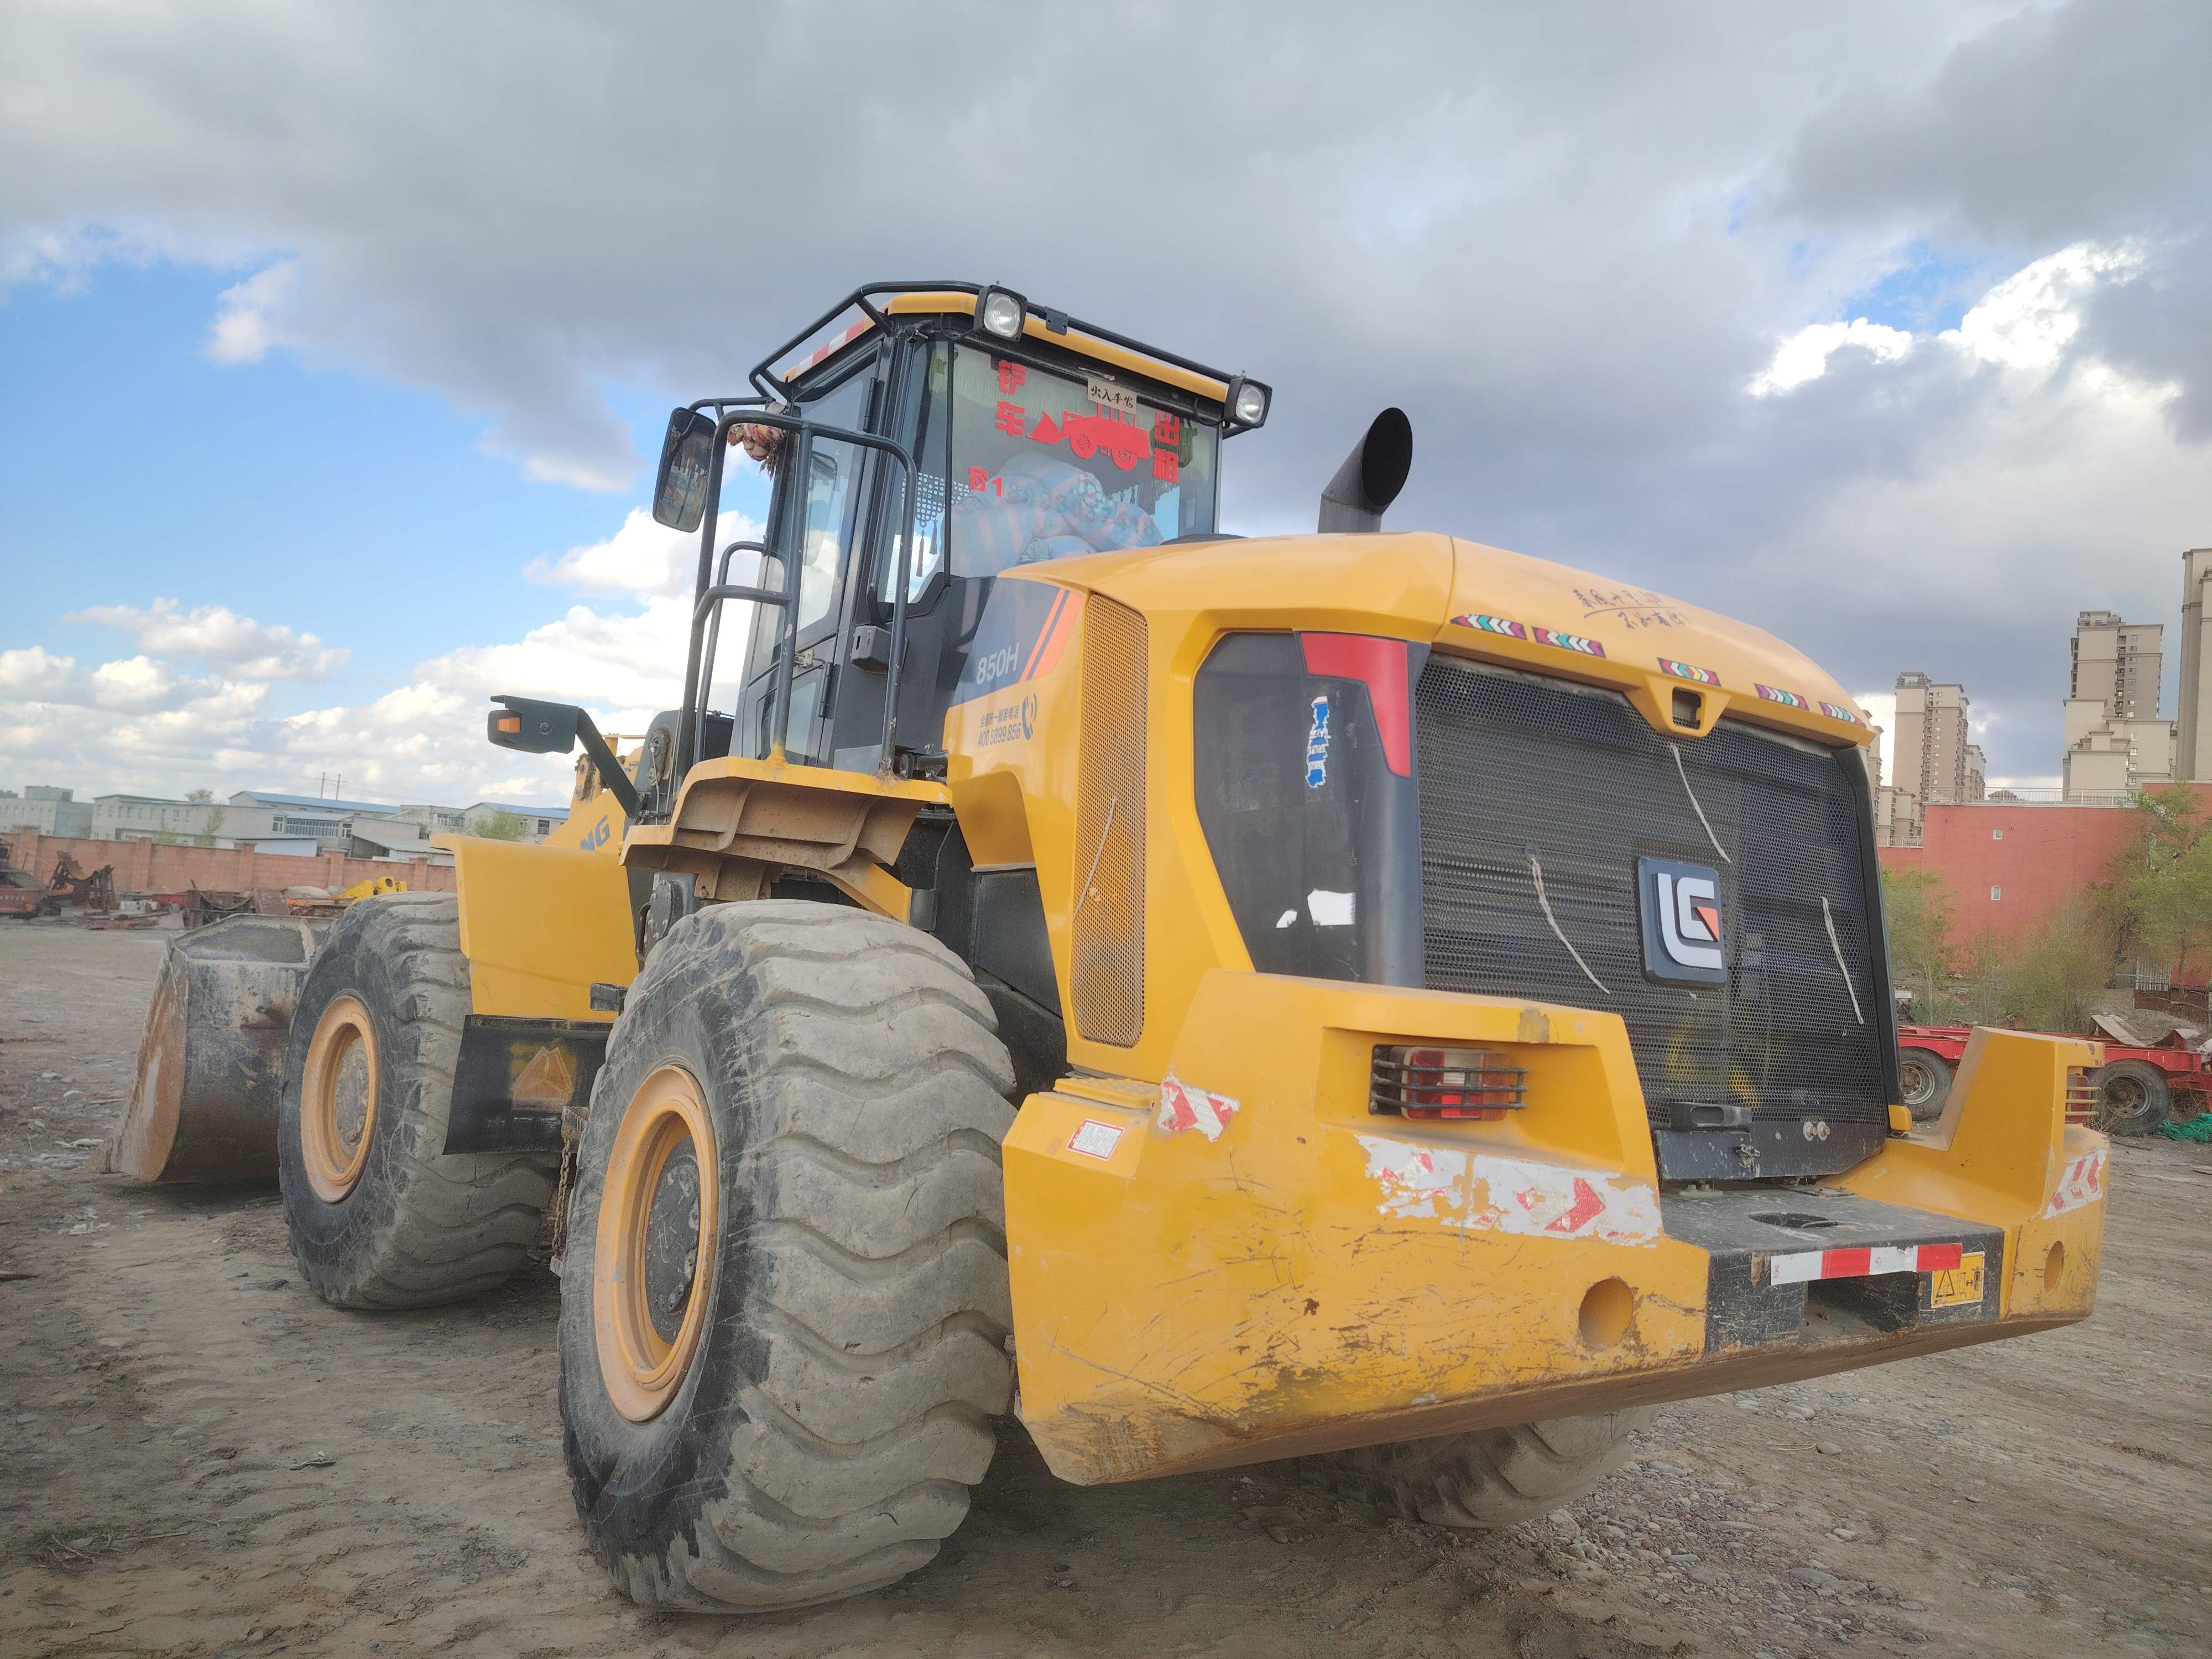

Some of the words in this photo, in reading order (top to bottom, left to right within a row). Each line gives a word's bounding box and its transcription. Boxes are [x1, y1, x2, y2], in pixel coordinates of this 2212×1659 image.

[996, 359, 1026, 436] 铲车
[1091, 385, 1133, 408] 出入平安
[1152, 411, 1180, 484] 出租
[976, 643, 1020, 685] 850H
[977, 730, 990, 748] 400
[990, 726, 1007, 745] 8899
[1007, 722, 1021, 742] 856
